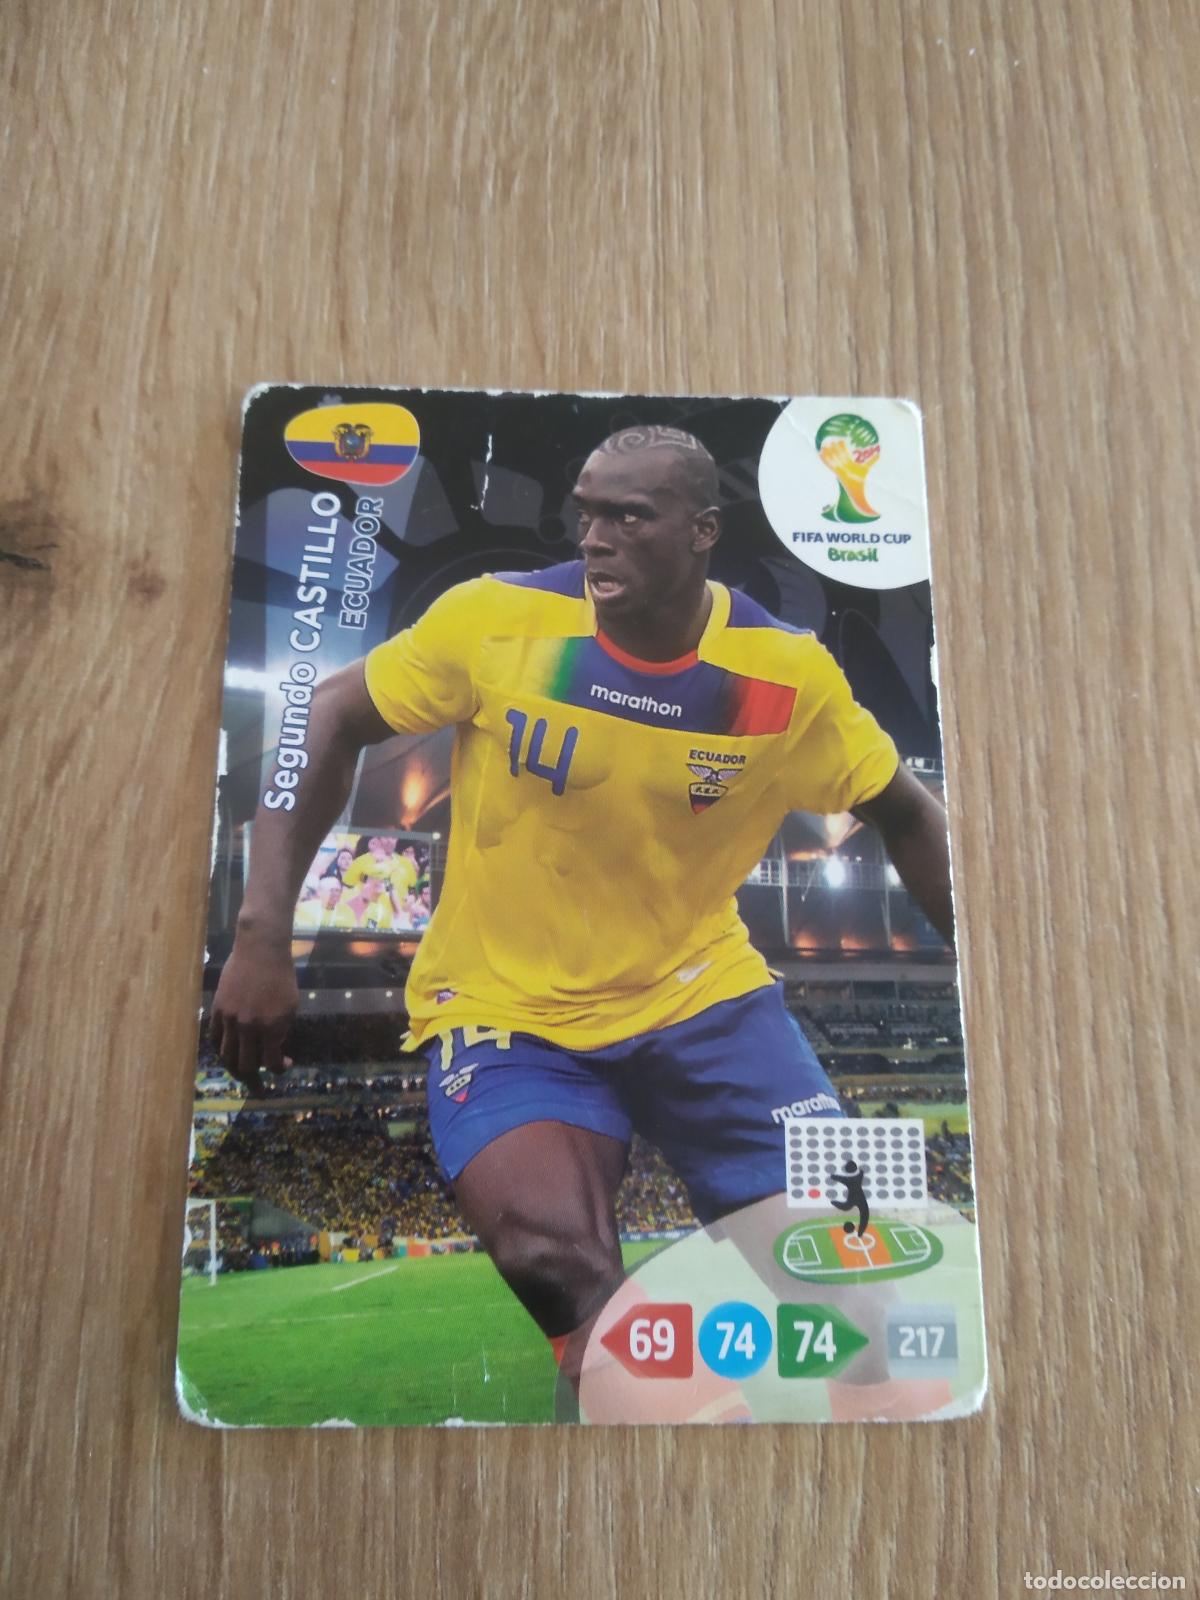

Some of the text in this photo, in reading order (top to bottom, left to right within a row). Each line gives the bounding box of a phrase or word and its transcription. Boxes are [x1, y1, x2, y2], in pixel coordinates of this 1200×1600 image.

[792, 532, 911, 544] FIFA WORLD CUP
[828, 547, 879, 562] Brasil
[338, 496, 384, 631] ECUADOR
[264, 491, 341, 812] Segundo CASTILLO
[590, 683, 682, 718] marathon
[505, 708, 579, 797] 14
[689, 749, 746, 764] ECUADOR
[629, 1318, 675, 1361] 69
[716, 1321, 756, 1360] 74
[793, 1320, 837, 1362] 74
[898, 1326, 945, 1358] 217
